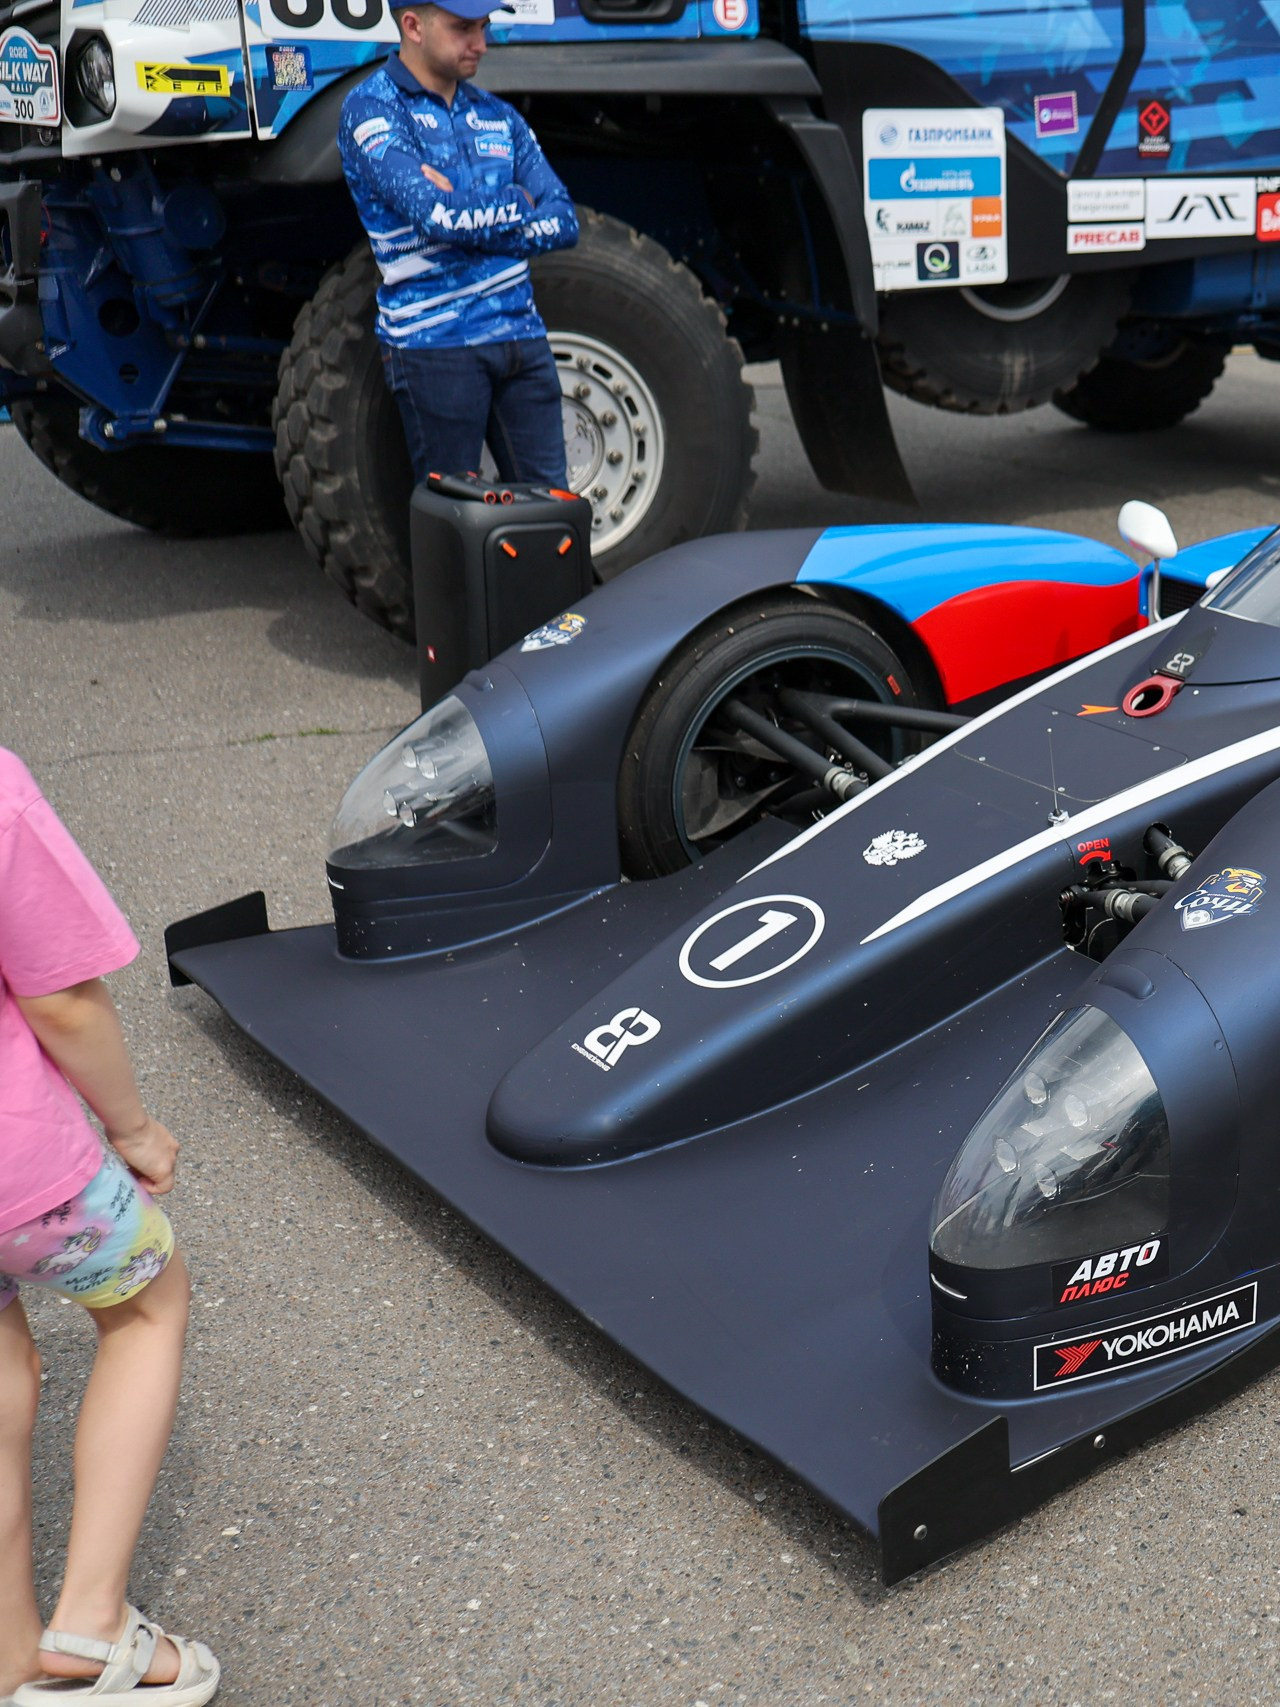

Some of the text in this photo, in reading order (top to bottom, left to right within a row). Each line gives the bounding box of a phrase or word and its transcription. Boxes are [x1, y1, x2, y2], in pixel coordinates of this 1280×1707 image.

[22, 61, 49, 83] WAY
[10, 83, 33, 93] RALLY
[13, 98, 35, 120] 300
[908, 128, 994, 142] ГАЗПРОМБАНК
[430, 202, 523, 231] KAMAZ
[1077, 837, 1111, 853] OPEN
[708, 909, 798, 971] 1
[1066, 1239, 1161, 1286] АВТО
[1059, 1272, 1130, 1304] ПЛЮС
[1101, 1299, 1241, 1361] YOKOHAMA
